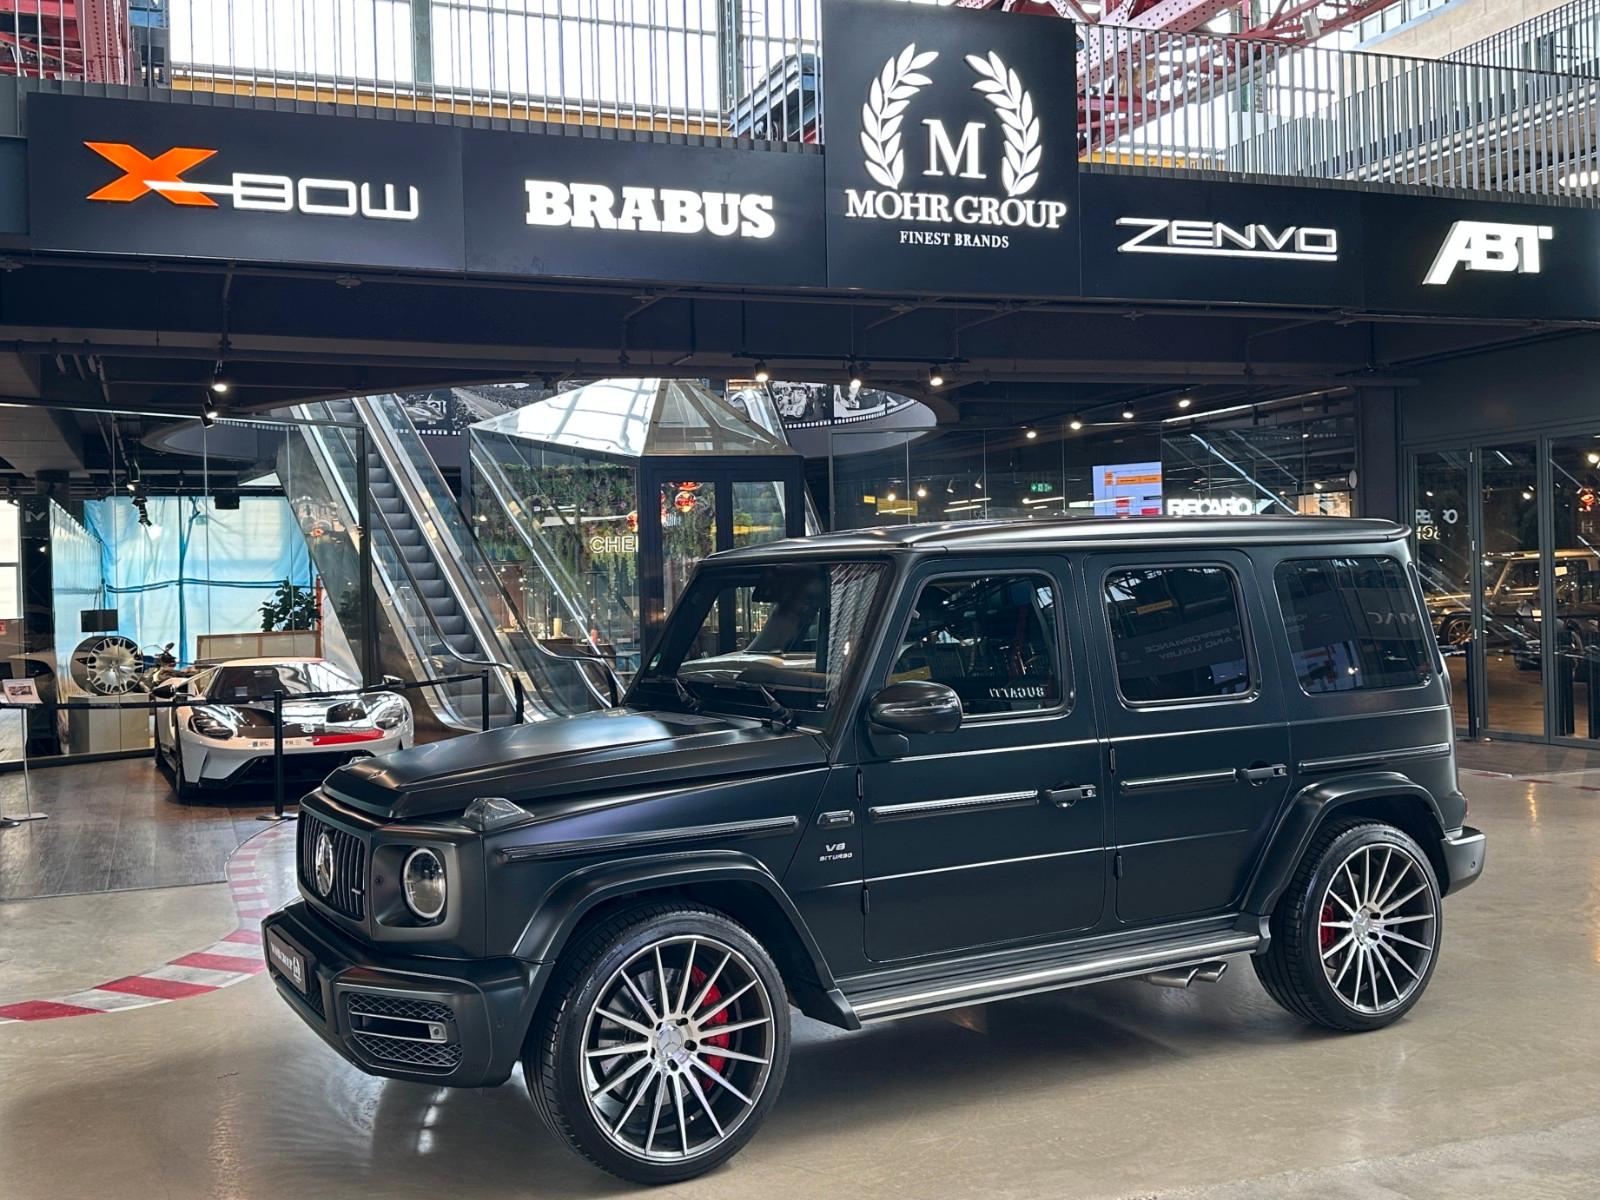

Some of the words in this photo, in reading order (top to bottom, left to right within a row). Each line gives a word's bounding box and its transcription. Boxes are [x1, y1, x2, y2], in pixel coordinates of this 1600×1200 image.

[921, 118, 987, 180] M
[524, 179, 777, 239] BRABUS
[845, 188, 953, 223] MOHR
[953, 195, 1067, 229] GROUP
[899, 230, 951, 246] FINEST
[954, 233, 1010, 249] BRANDS
[1115, 217, 1338, 262] ZENVO
[1422, 220, 1554, 285] ABT
[1167, 497, 1253, 516] RECARO
[825, 842, 846, 852] V8
